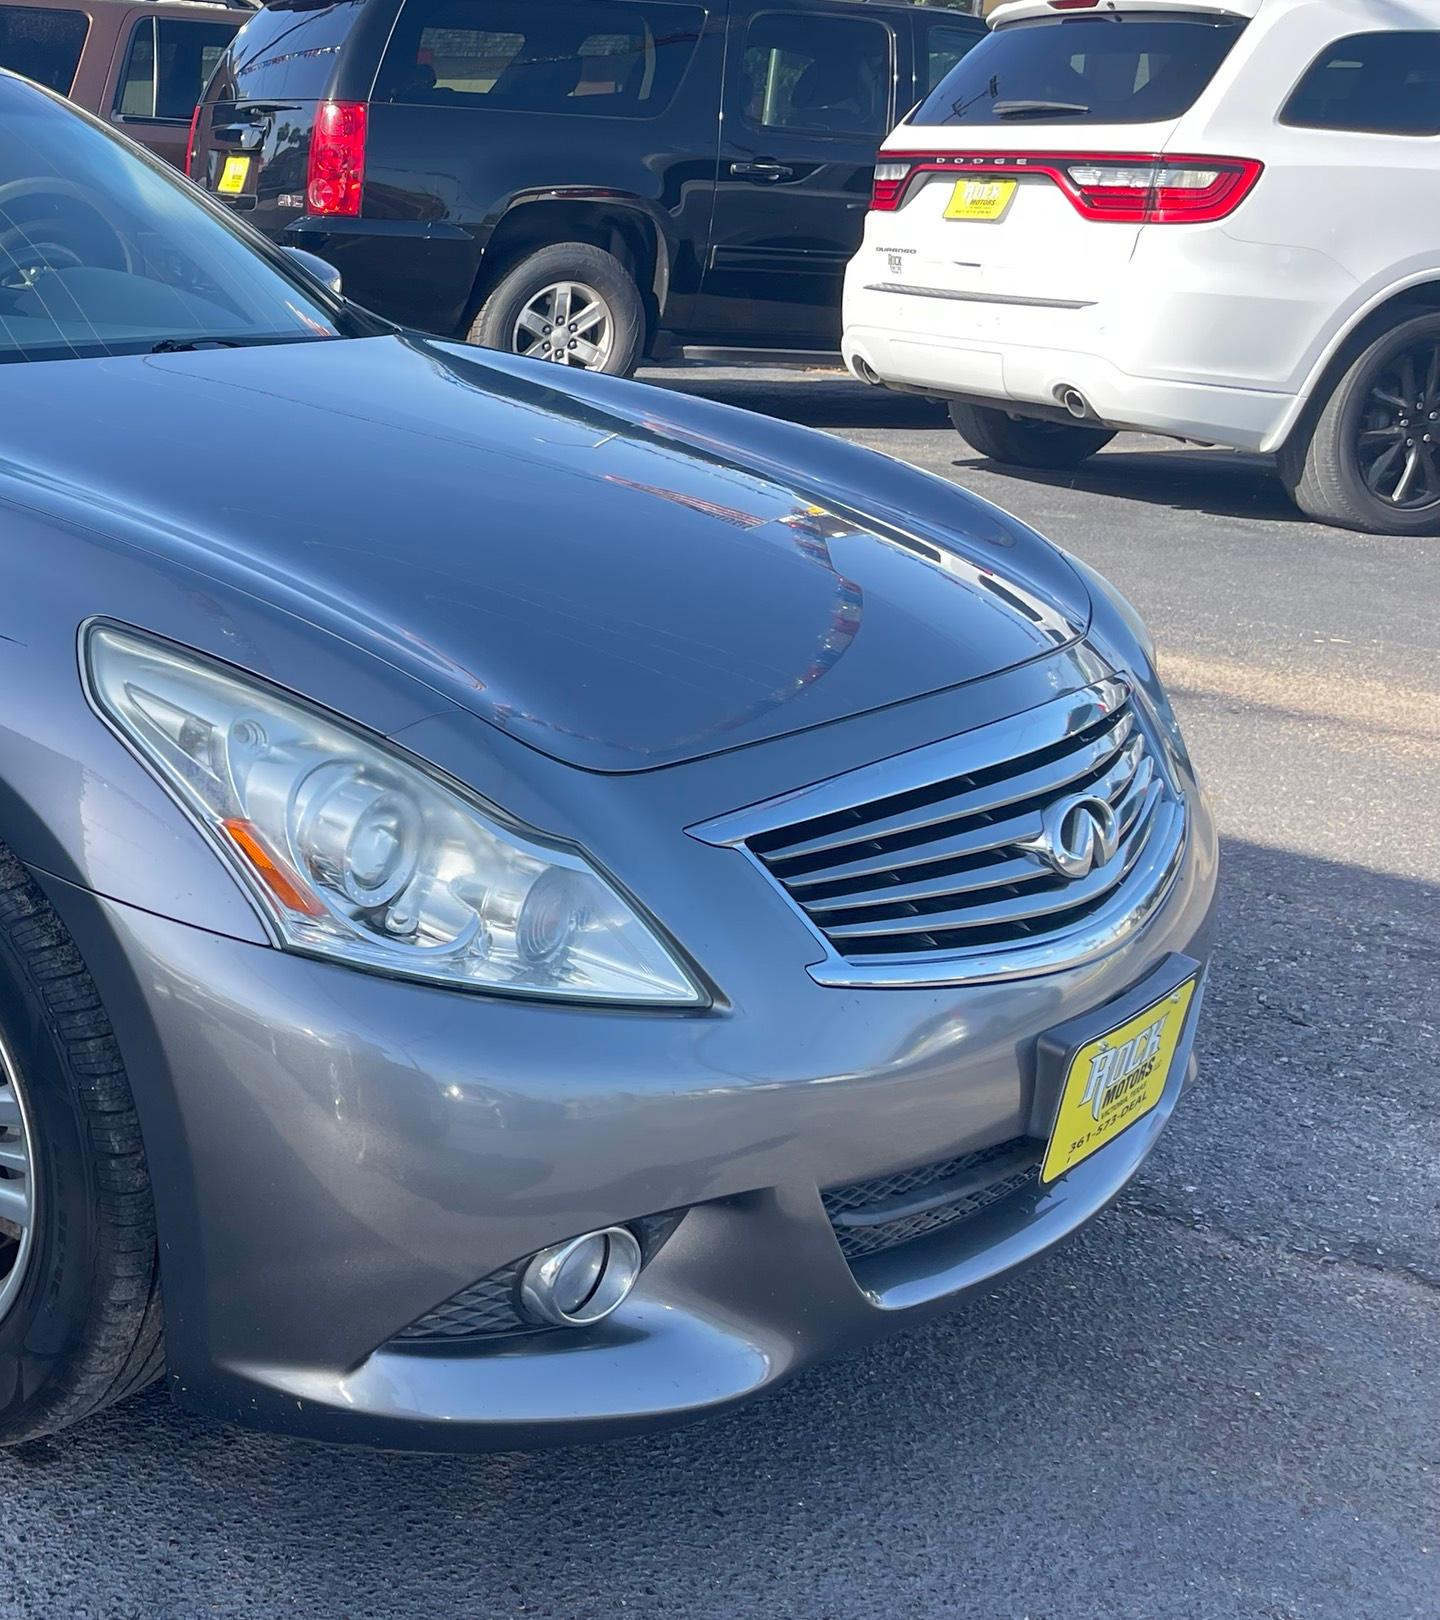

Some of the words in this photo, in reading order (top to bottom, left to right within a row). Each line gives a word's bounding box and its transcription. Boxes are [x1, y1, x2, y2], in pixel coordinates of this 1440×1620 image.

[935, 157, 1028, 165] DODGE
[1077, 1011, 1170, 1122] ROCK
[1102, 1056, 1156, 1109] MOTORS
[1068, 1091, 1147, 1154] 361-573-DEAL
